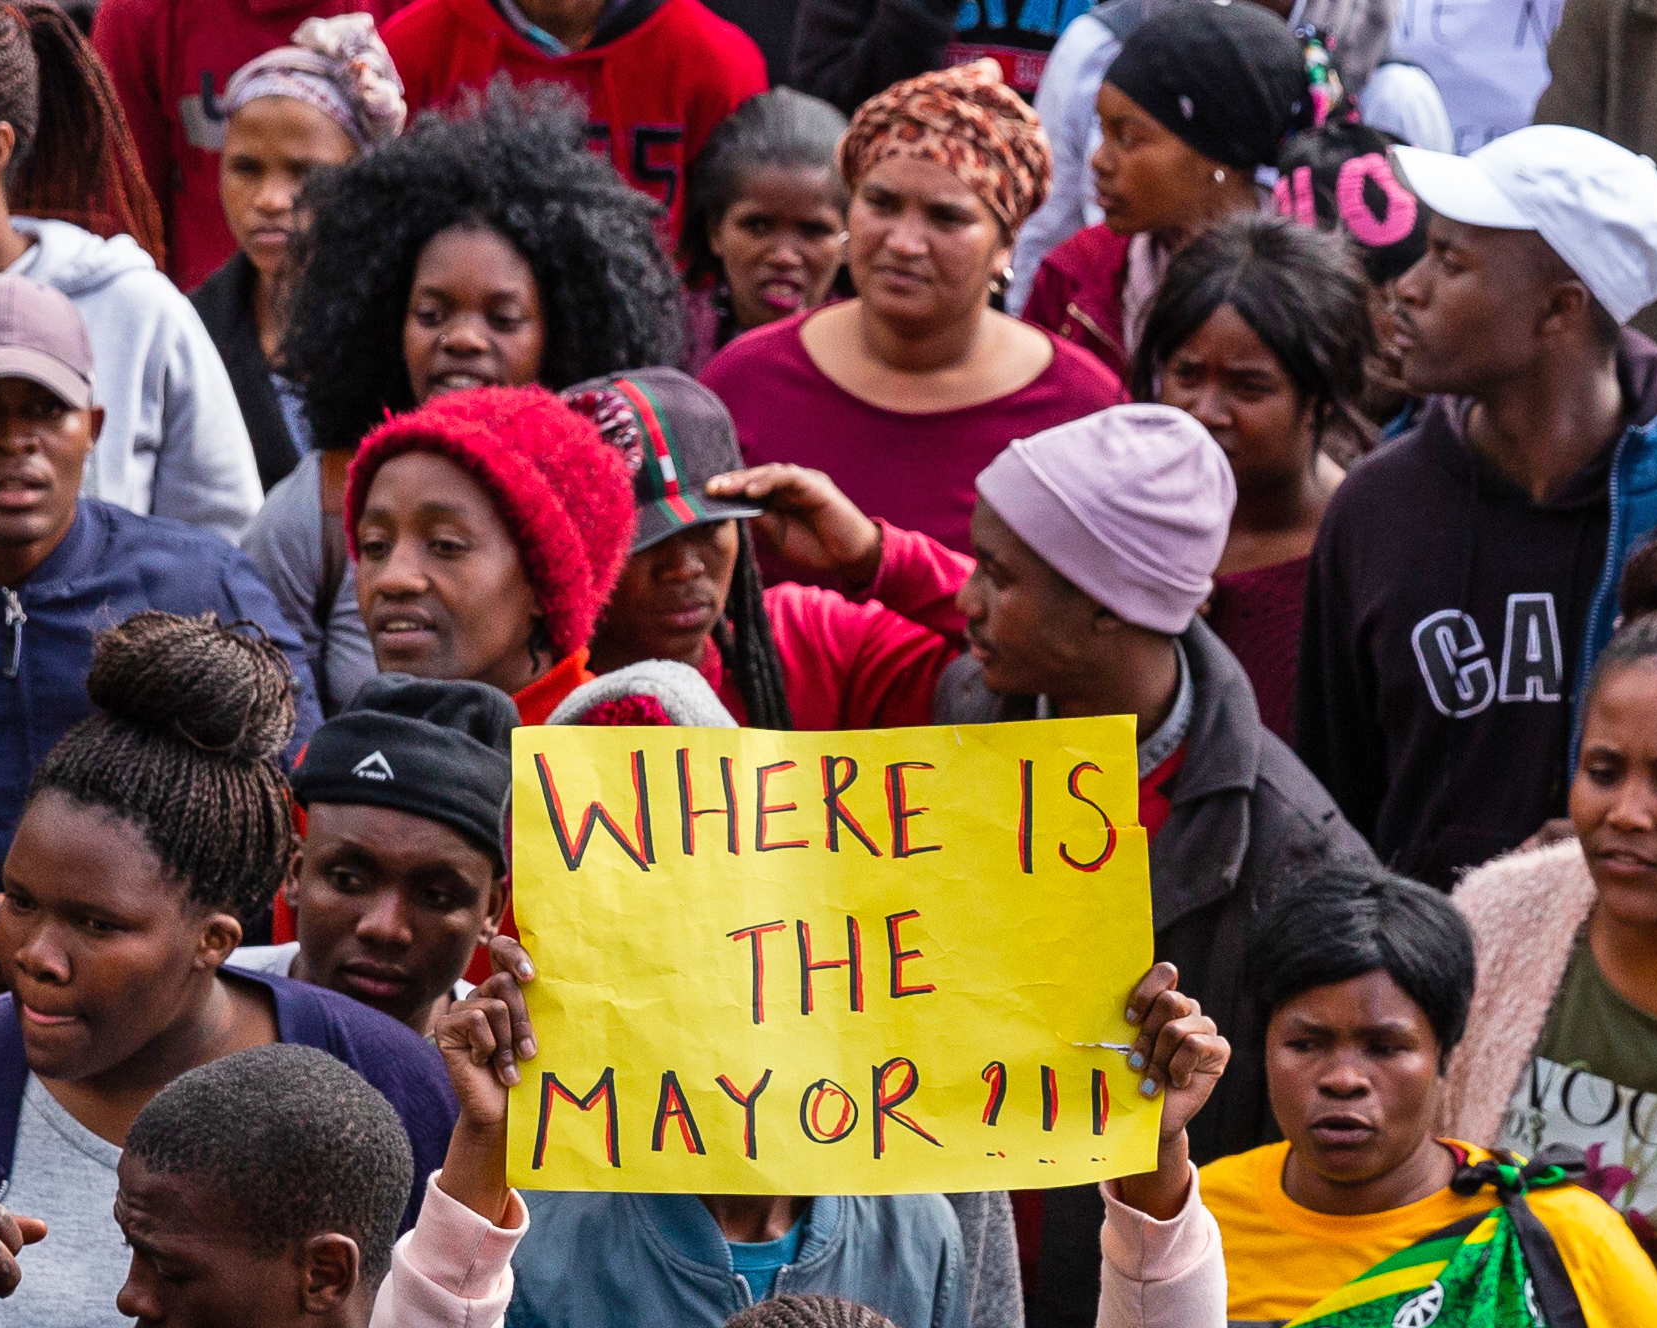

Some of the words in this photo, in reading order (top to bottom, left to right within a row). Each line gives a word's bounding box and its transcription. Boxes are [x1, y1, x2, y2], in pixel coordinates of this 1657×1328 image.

[534, 748, 943, 871] WHERE
[1018, 758, 1117, 874] IS
[726, 910, 937, 1024] THE
